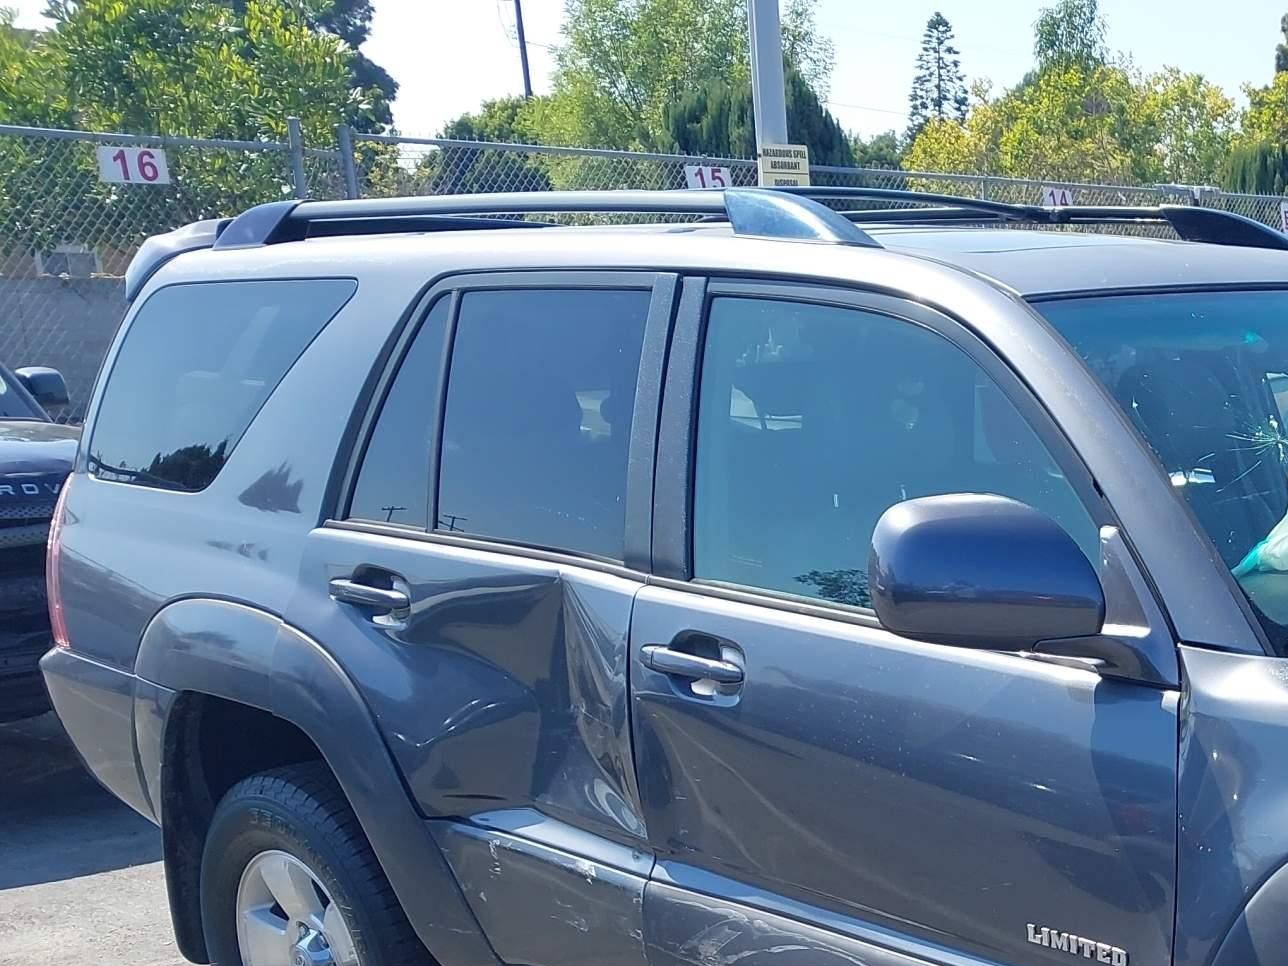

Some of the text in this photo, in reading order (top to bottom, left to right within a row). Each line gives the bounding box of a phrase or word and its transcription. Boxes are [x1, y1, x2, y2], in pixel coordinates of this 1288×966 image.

[112, 149, 159, 182] 16
[694, 167, 725, 188] 15
[1049, 190, 1069, 206] 14
